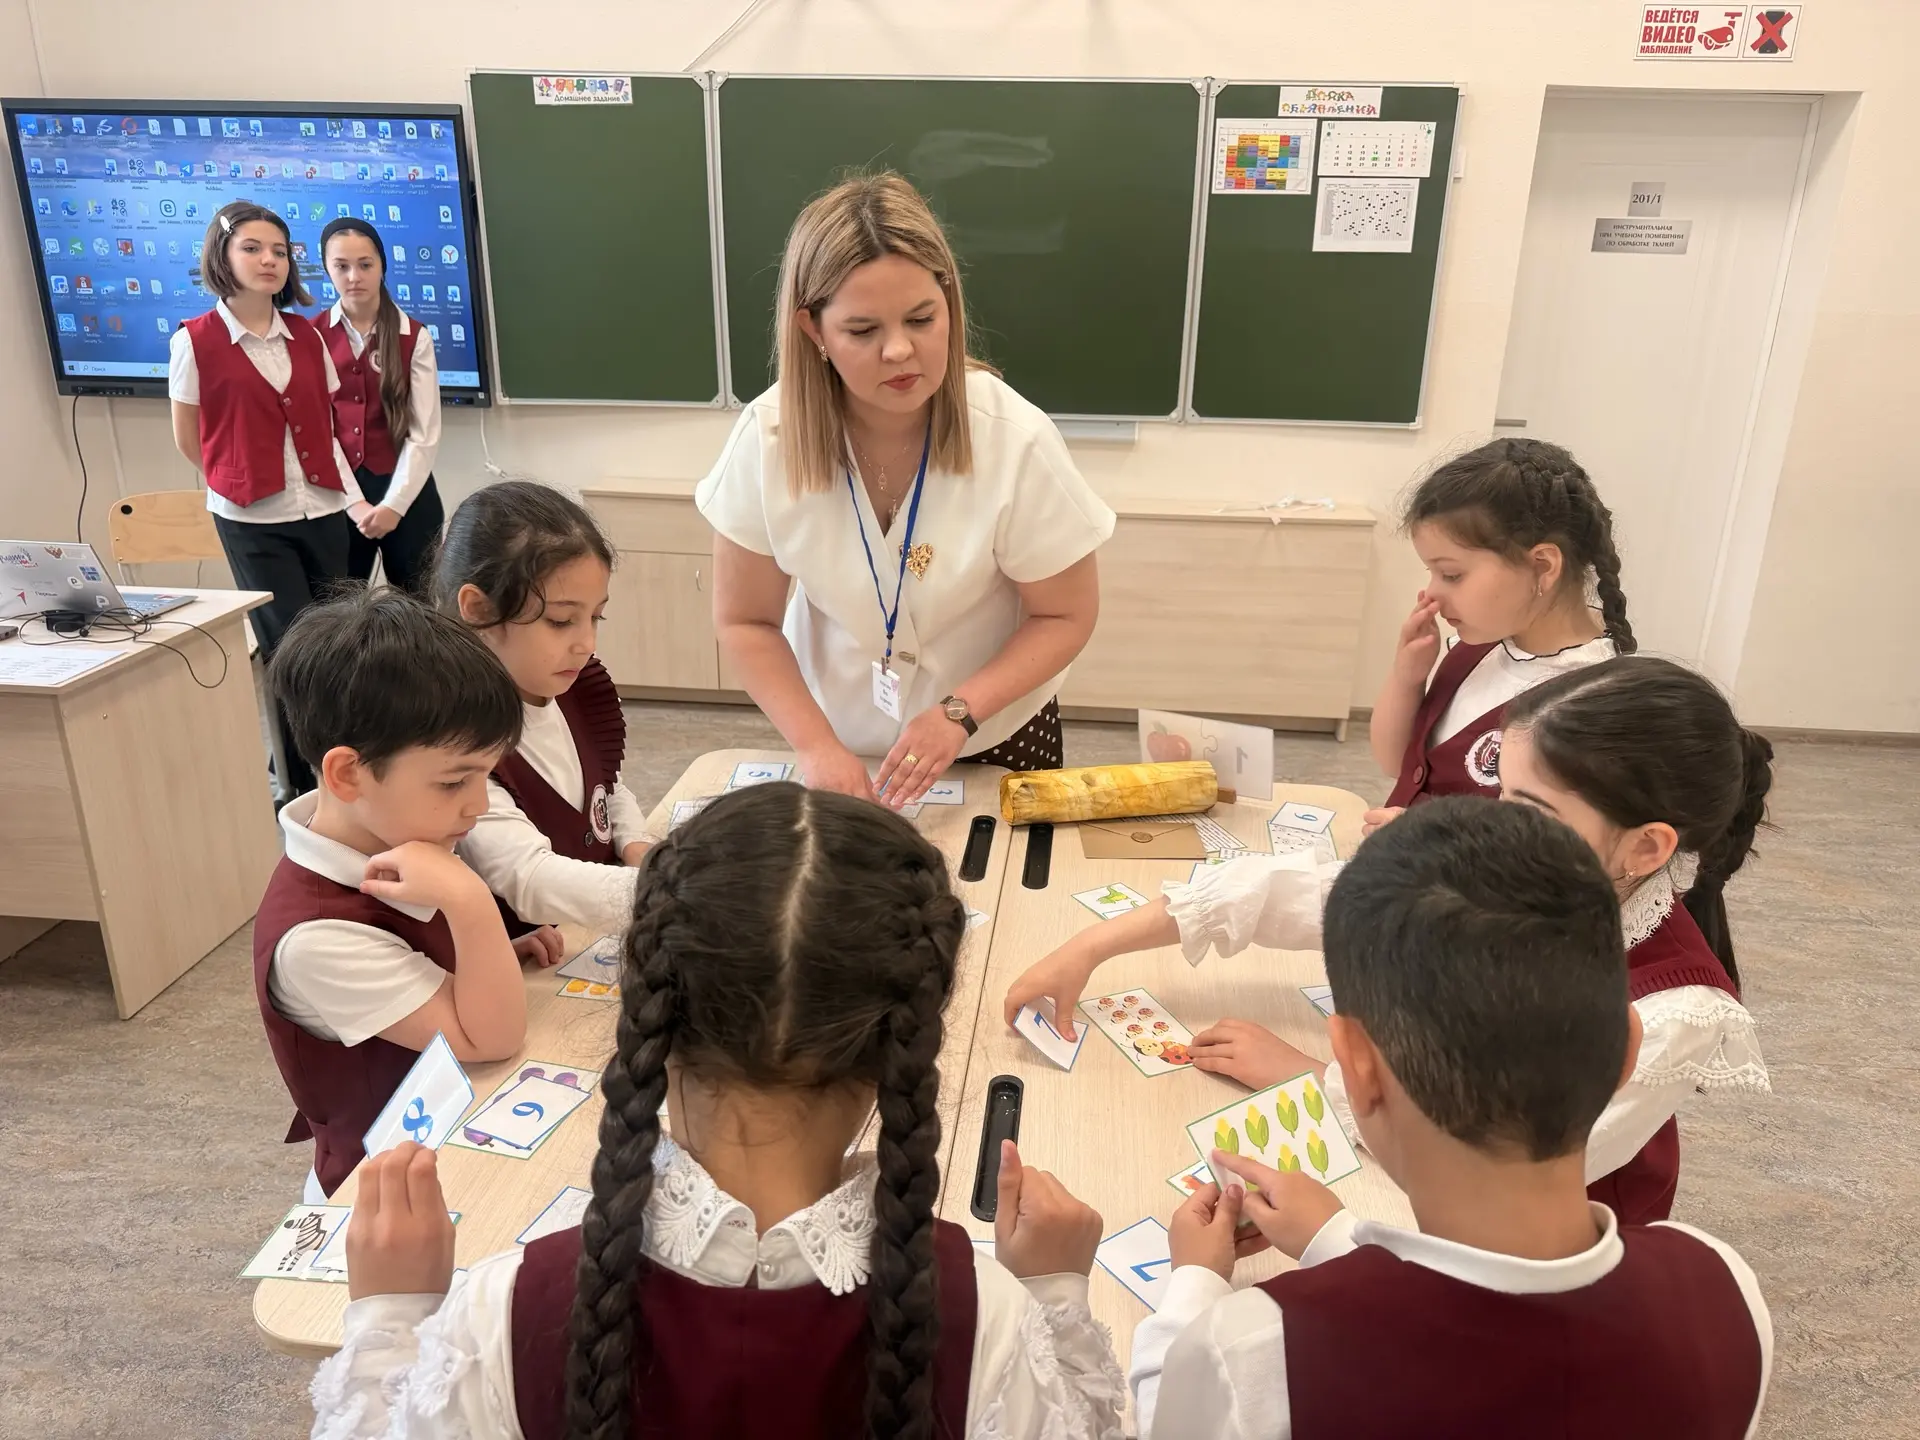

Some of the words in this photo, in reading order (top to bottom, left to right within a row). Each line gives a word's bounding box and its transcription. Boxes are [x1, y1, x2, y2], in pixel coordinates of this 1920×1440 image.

[1645, 8, 1699, 23] ВЕДЁТСЯ
[1641, 26, 1696, 43] ВИДЕО
[1640, 45, 1693, 54] НАБЛЮДЕНИЕ
[1632, 194, 1661, 204] 201/1
[403, 1097, 433, 1143] 8
